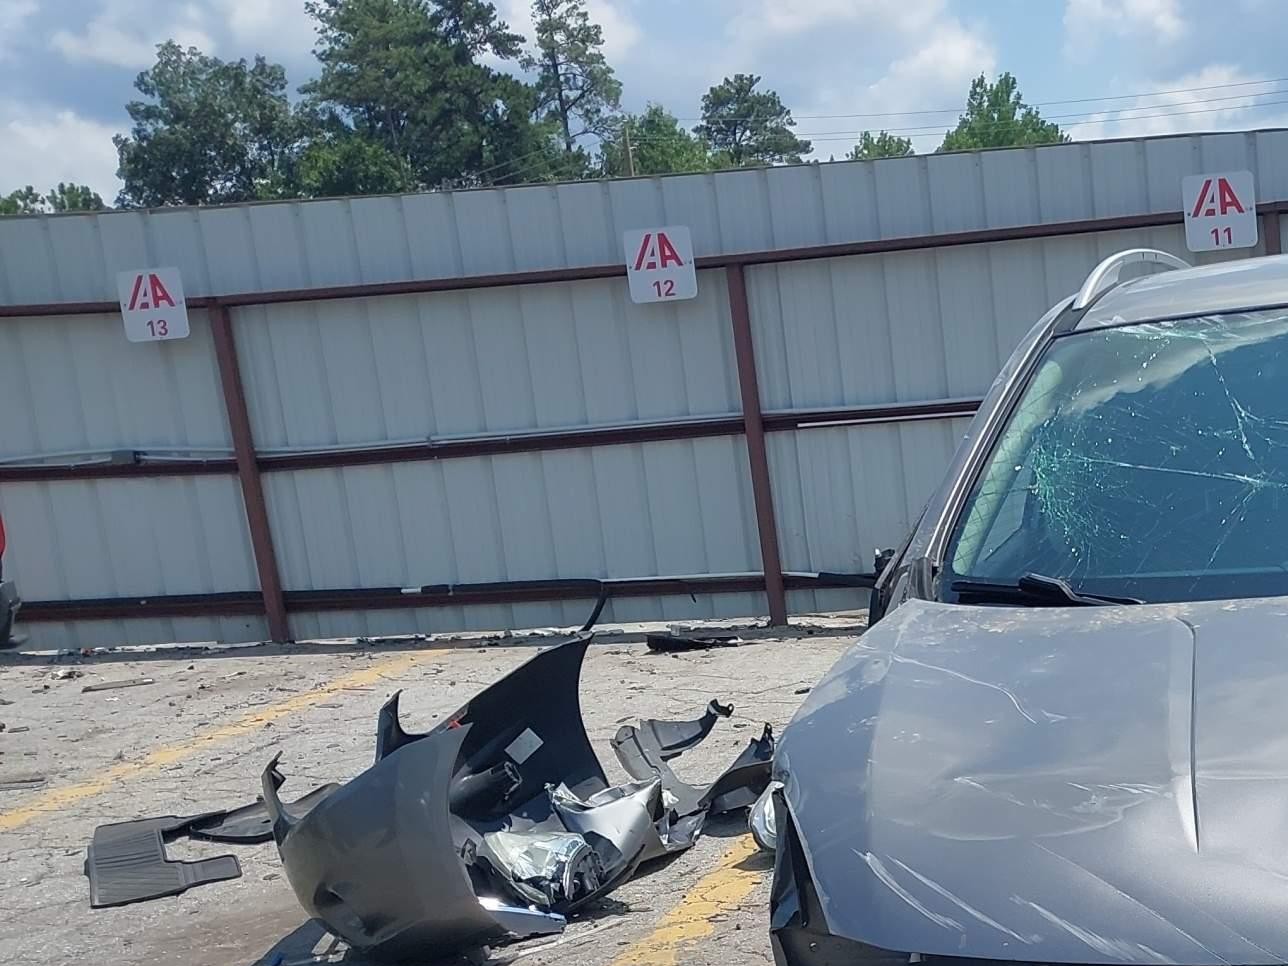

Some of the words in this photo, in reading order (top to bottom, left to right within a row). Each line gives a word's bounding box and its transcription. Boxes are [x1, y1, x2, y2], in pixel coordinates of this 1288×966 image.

[1210, 227, 1233, 246] 11
[652, 280, 676, 298] 12
[146, 319, 169, 338] 13
